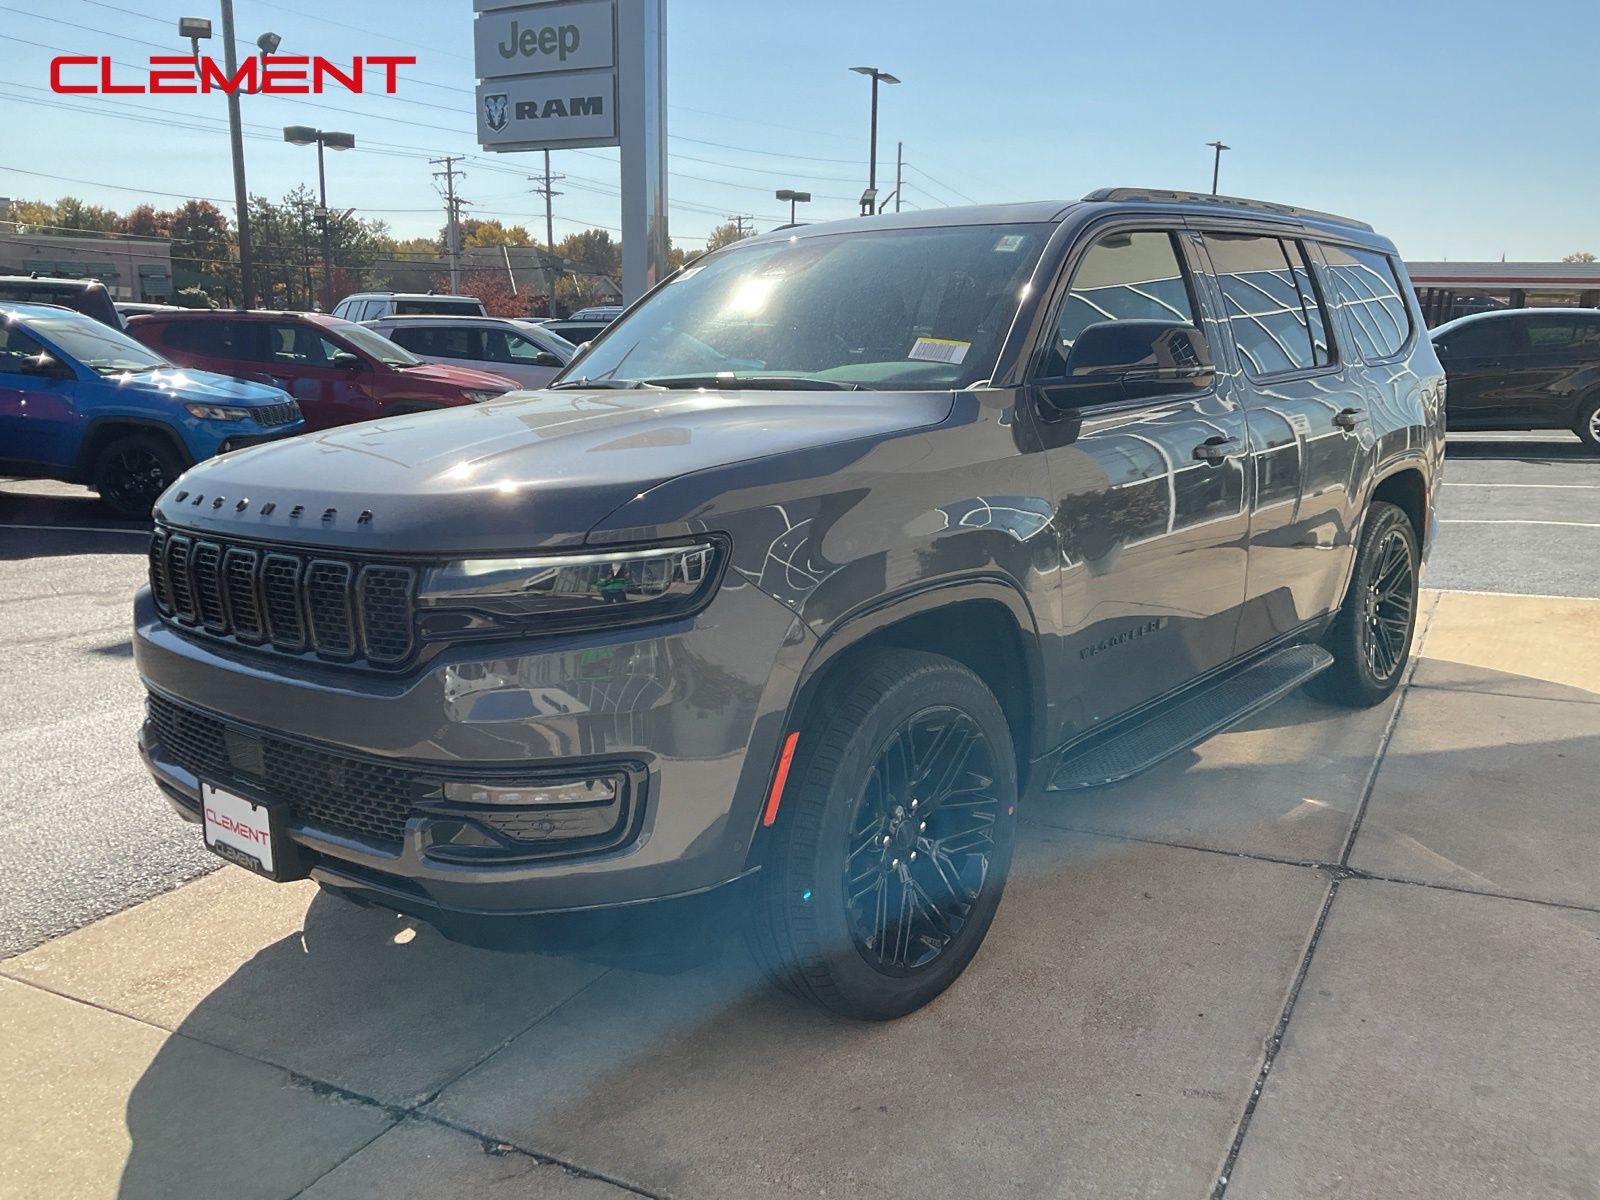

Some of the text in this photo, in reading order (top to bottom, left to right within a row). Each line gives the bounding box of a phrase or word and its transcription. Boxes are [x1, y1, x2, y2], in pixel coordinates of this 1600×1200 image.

[498, 21, 580, 61] Jeep
[515, 96, 603, 120] RAM
[175, 490, 373, 525] WAGONEER
[206, 808, 269, 846] CLEMENT
